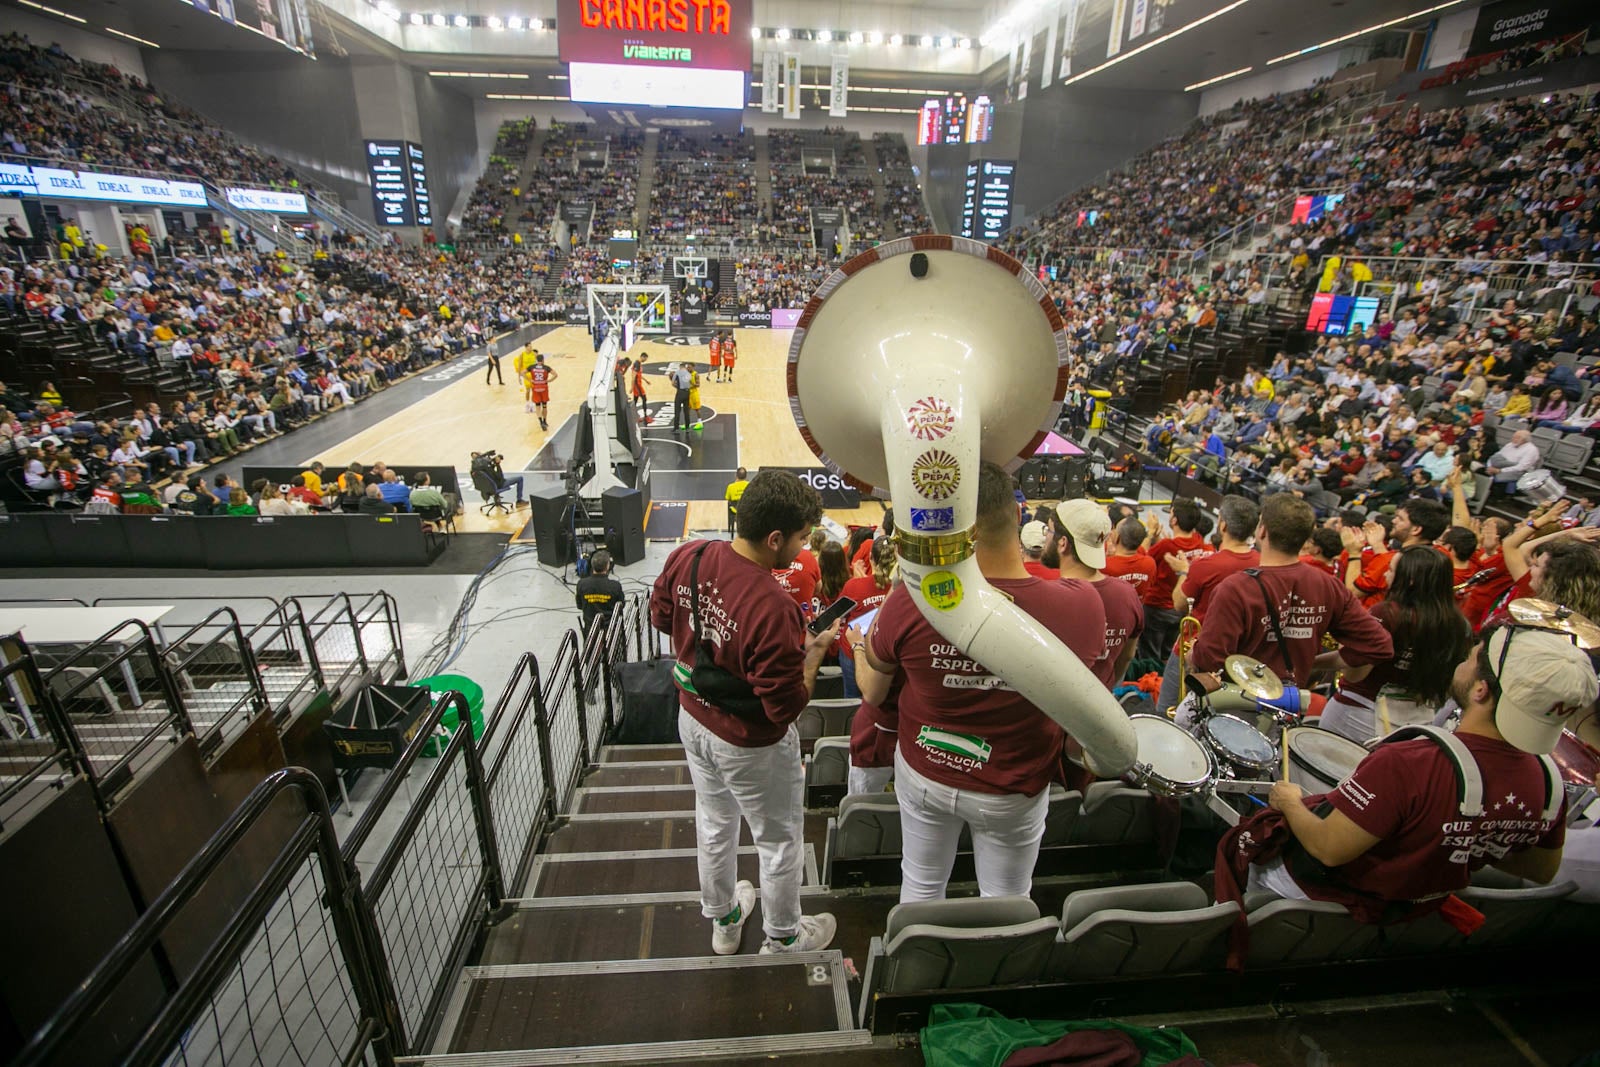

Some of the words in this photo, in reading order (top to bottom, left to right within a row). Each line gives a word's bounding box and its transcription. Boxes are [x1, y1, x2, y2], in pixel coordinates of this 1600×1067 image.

[1493, 9, 1550, 31] Granada
[1490, 31, 1502, 42] es
[1502, 21, 1545, 39] deporte
[49, 177, 86, 190] IDEAL
[99, 181, 133, 194] IDEAL
[141, 186, 173, 197] IDEAL
[740, 312, 771, 321] endesa
[920, 416, 943, 424] PEPA
[922, 473, 951, 481] PEPA
[1318, 605, 1327, 613] EL
[1442, 821, 1473, 835] QUE
[1480, 820, 1539, 831] COMIENCE
[813, 965, 828, 982] 8
